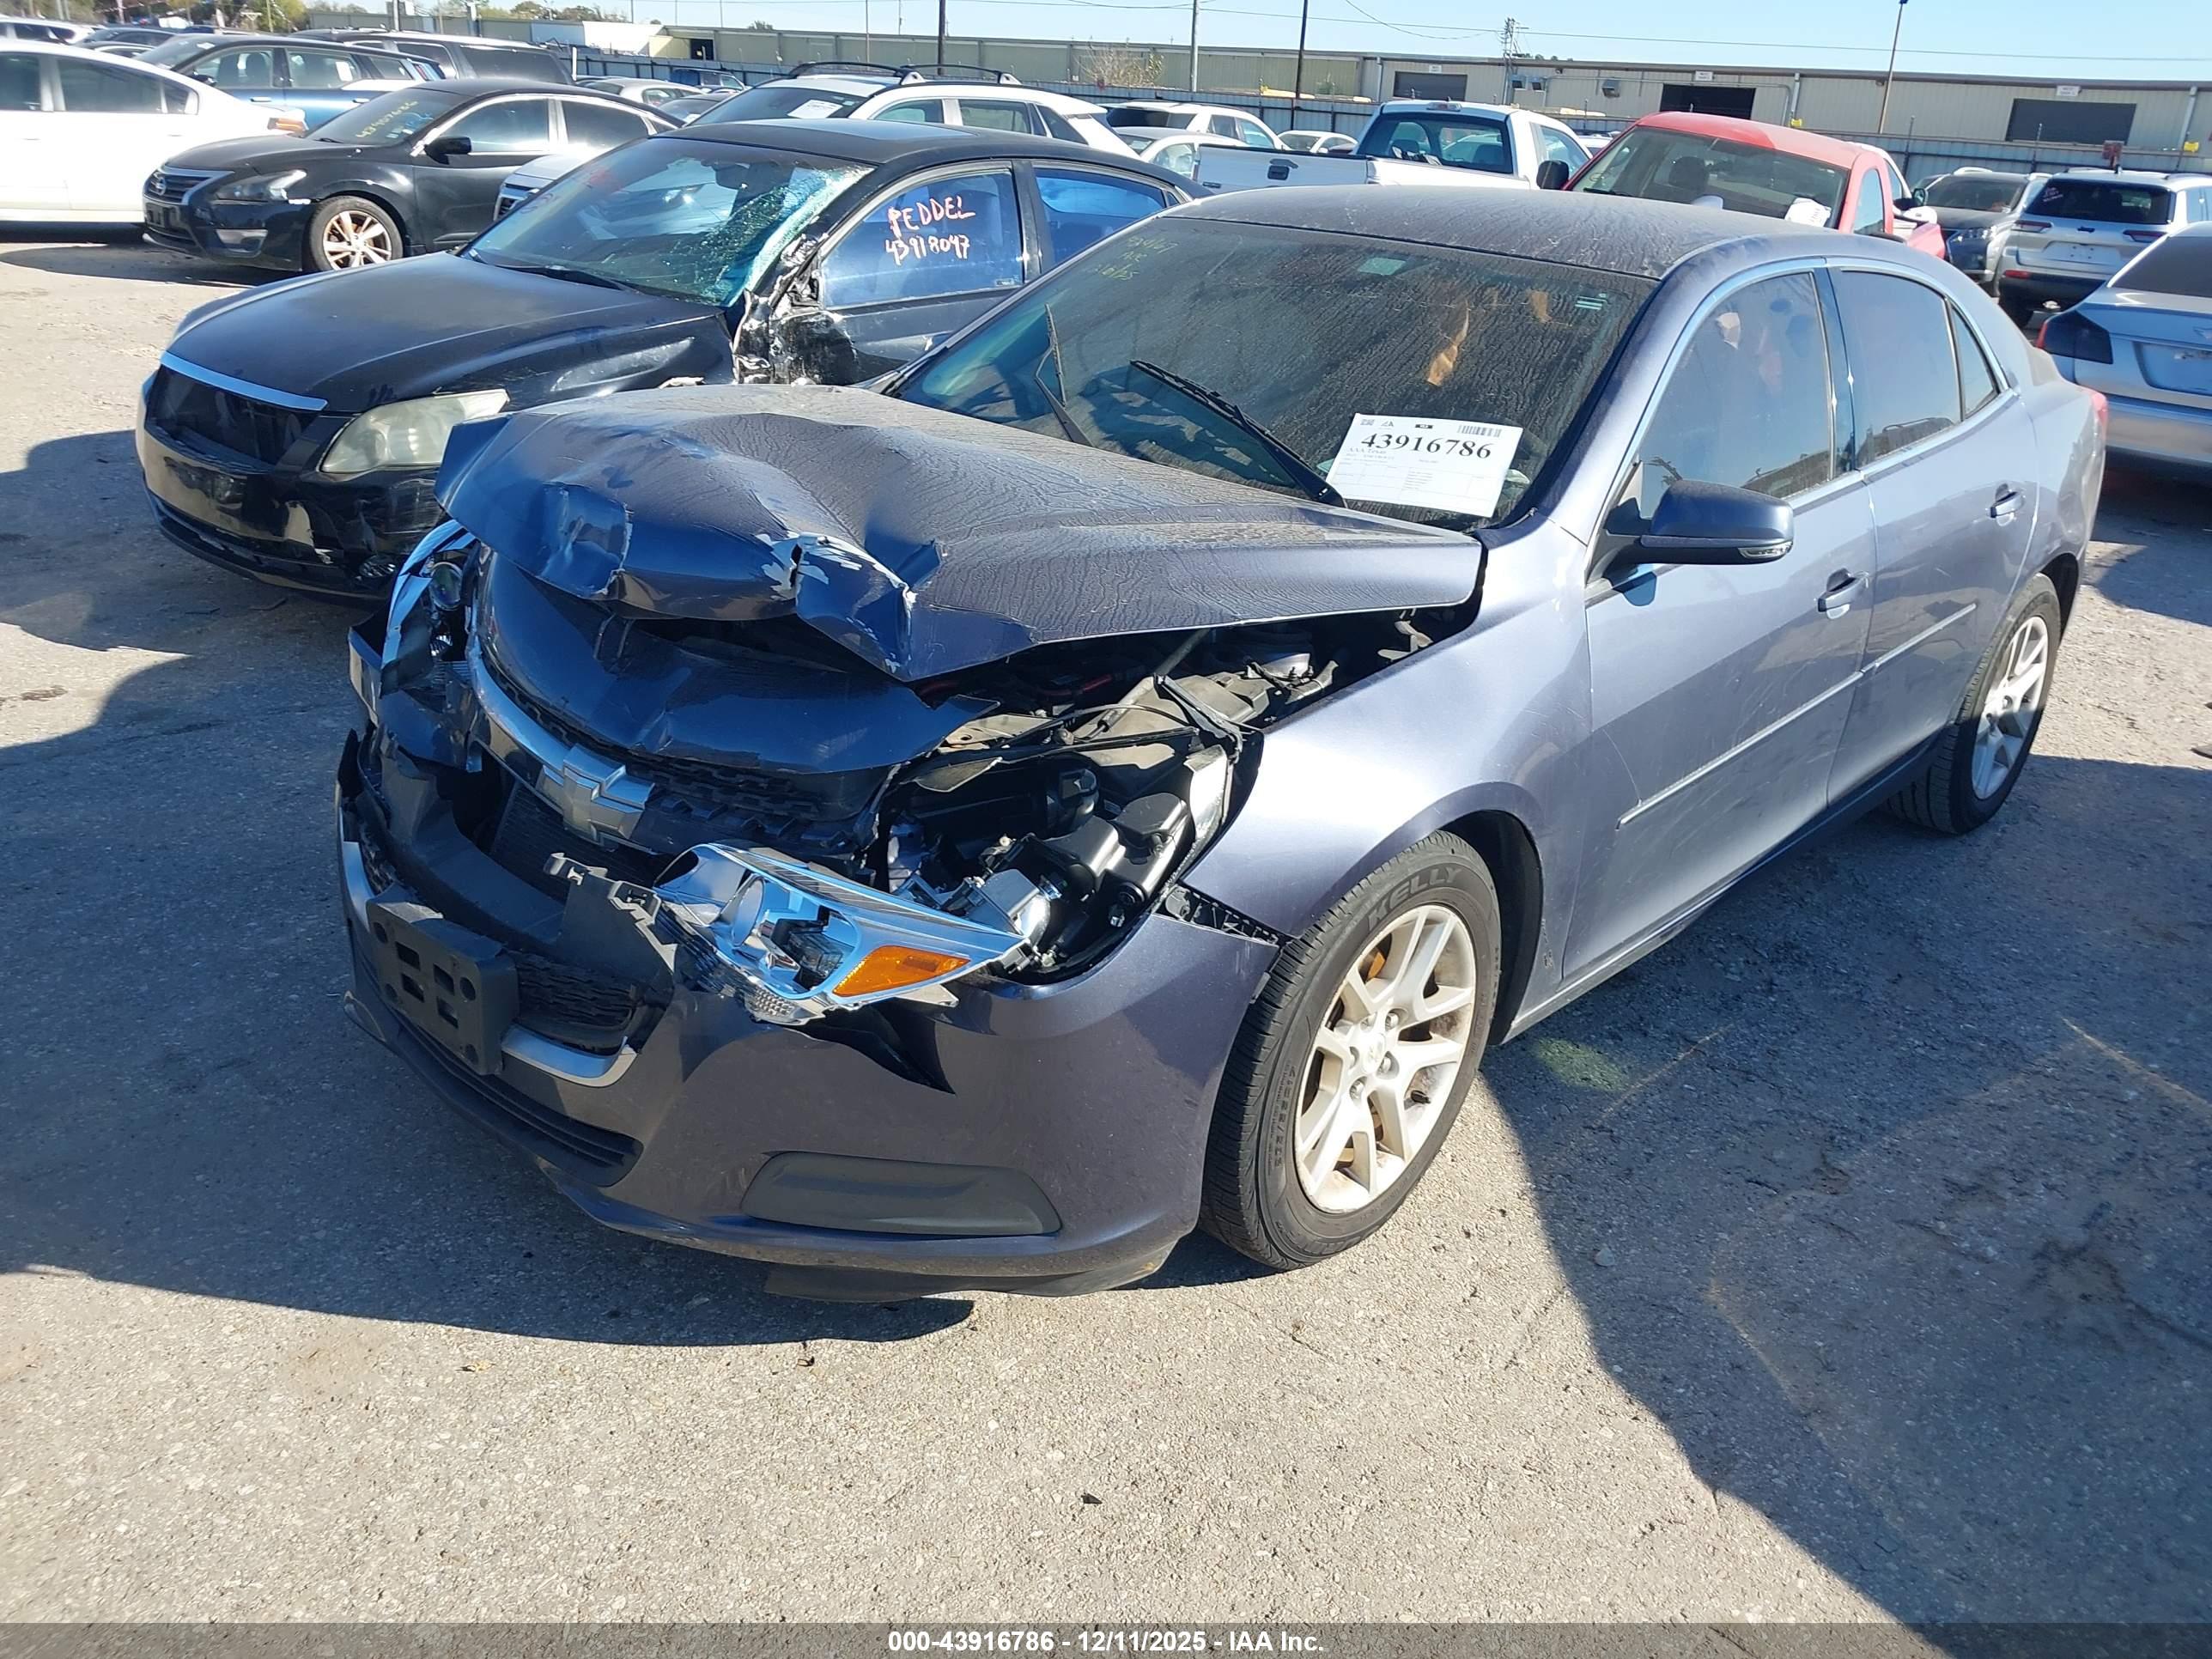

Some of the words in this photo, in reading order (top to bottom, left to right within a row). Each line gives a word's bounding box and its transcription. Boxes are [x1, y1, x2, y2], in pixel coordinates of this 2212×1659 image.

[887, 195, 976, 238] PEDDEL
[885, 234, 970, 266] 43918047
[1361, 433, 1495, 459] 43916786
[1366, 866, 1463, 932] KELLY
